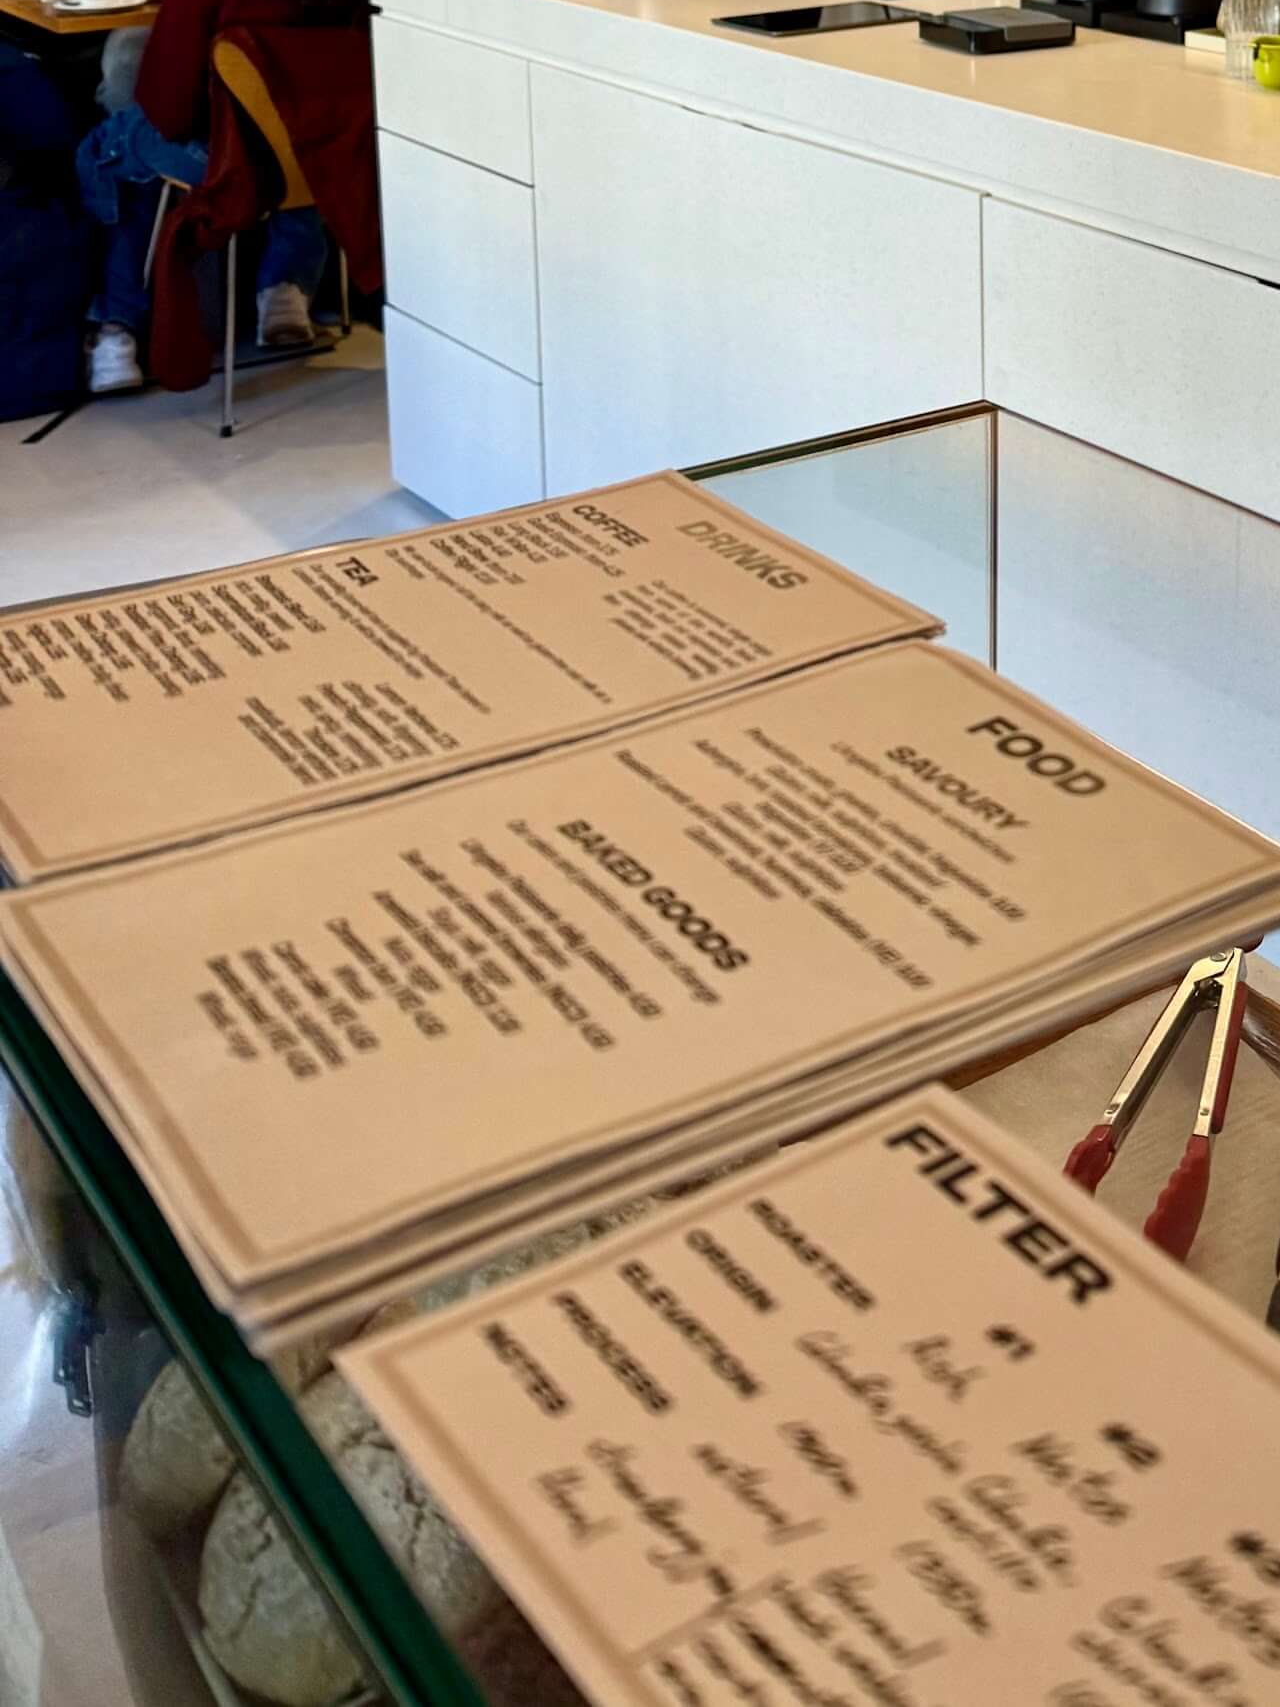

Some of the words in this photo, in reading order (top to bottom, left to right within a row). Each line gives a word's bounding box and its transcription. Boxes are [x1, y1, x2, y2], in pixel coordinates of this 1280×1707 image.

[572, 504, 650, 547] COFFEE
[675, 520, 809, 590] DRINKS
[336, 556, 379, 587] TEA
[885, 745, 1030, 829] SAVOURY
[966, 715, 1107, 797] FOOD
[557, 819, 654, 886] BAKED
[641, 886, 750, 971] GOODS
[748, 1198, 876, 1311] ROASTER
[884, 1124, 1114, 1306] FILTER
[685, 1228, 777, 1315] ORIGIN
[481, 1323, 574, 1417] NOTES
[551, 1291, 675, 1415] PROCESS
[618, 1260, 766, 1399] ELEVATION
